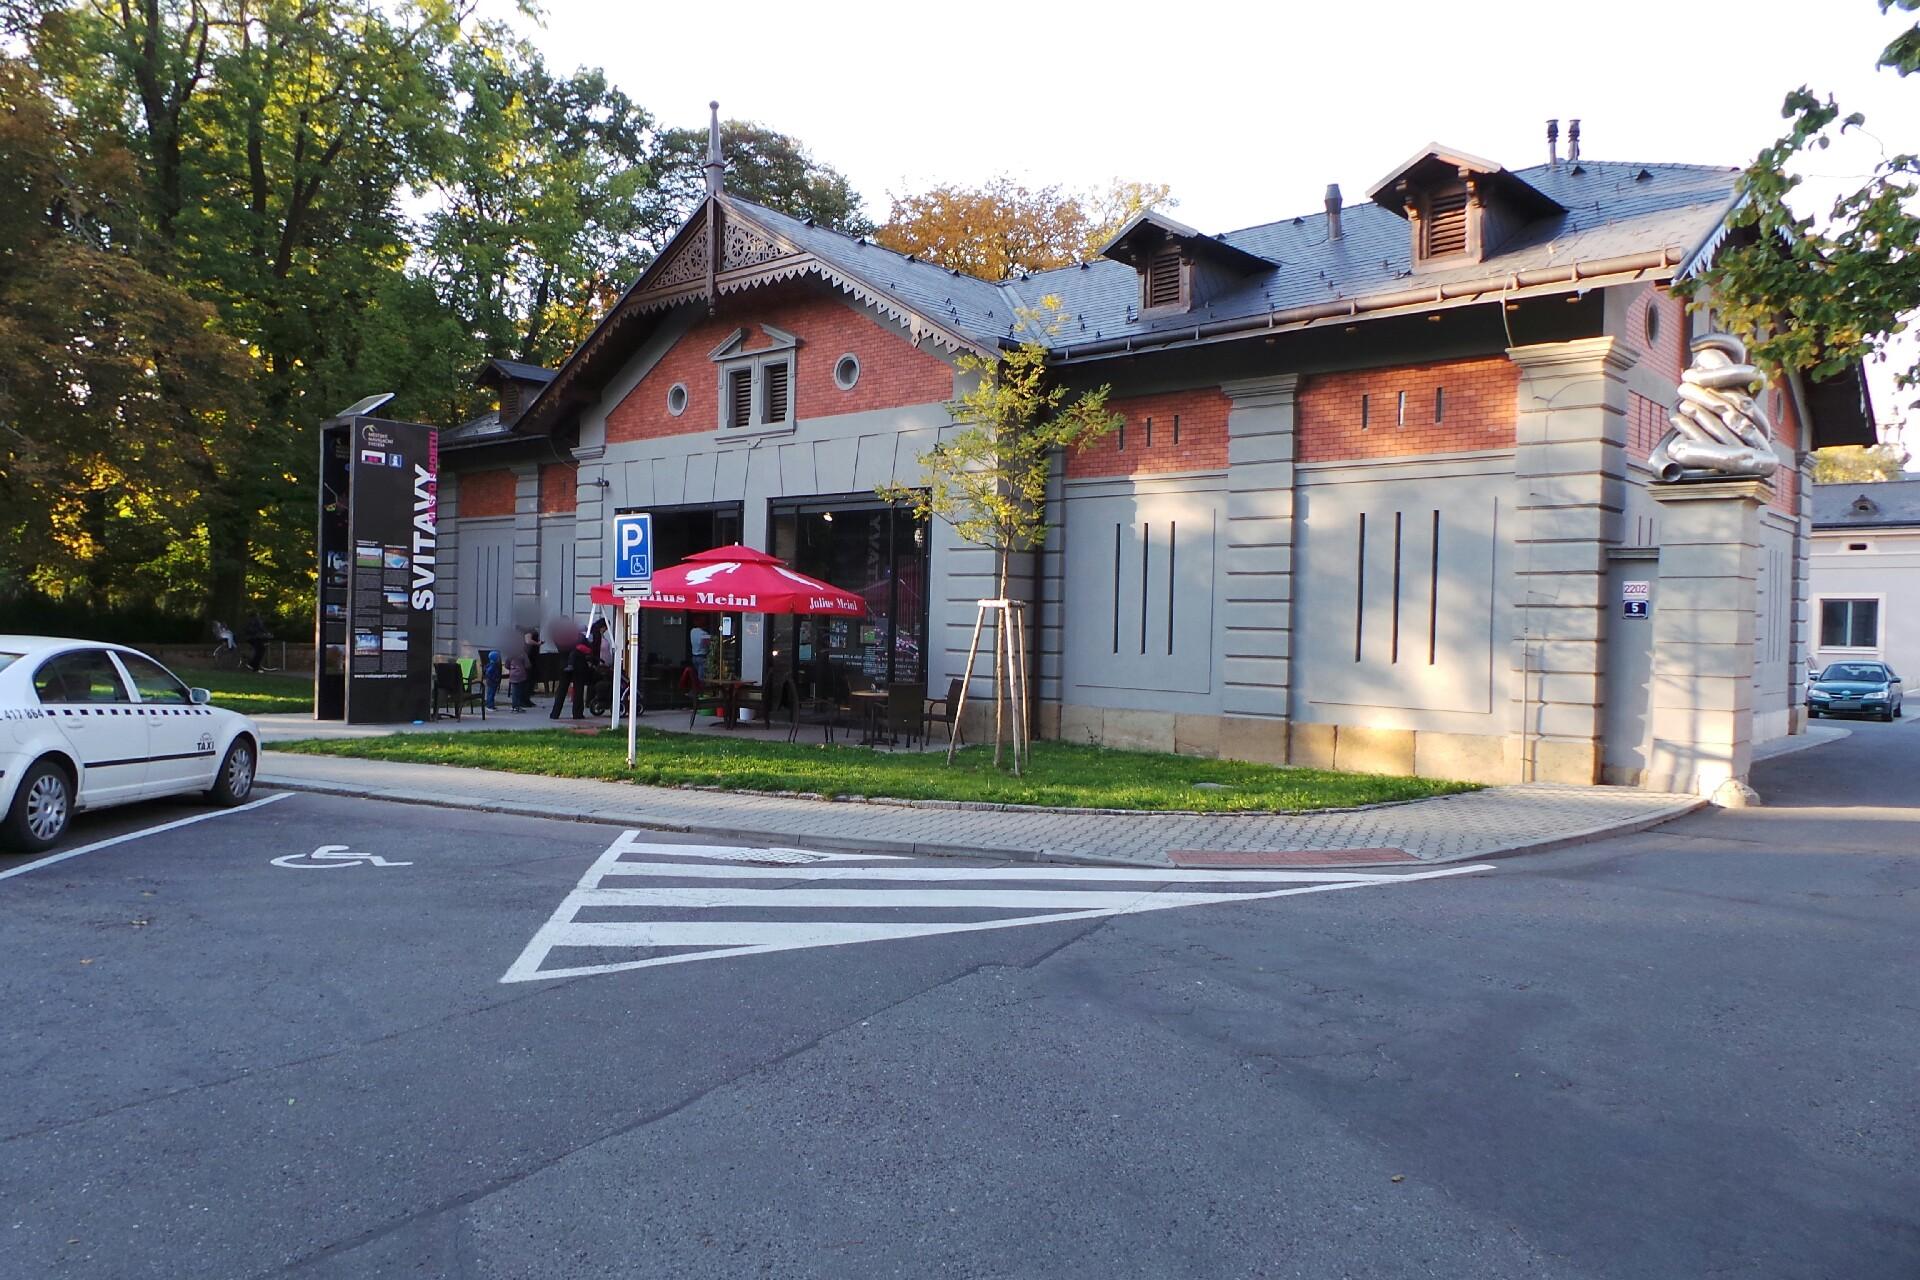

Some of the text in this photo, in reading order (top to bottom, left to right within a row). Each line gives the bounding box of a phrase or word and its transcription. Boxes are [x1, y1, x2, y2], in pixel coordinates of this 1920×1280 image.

[412, 464, 436, 611] SVITAVY
[622, 523, 643, 561] P
[1624, 584, 1647, 593] 2202
[695, 592, 757, 606] Meinl
[809, 597, 858, 611] Julius Meinl
[1631, 602, 1639, 613] 5
[196, 741, 214, 751] TAXI
